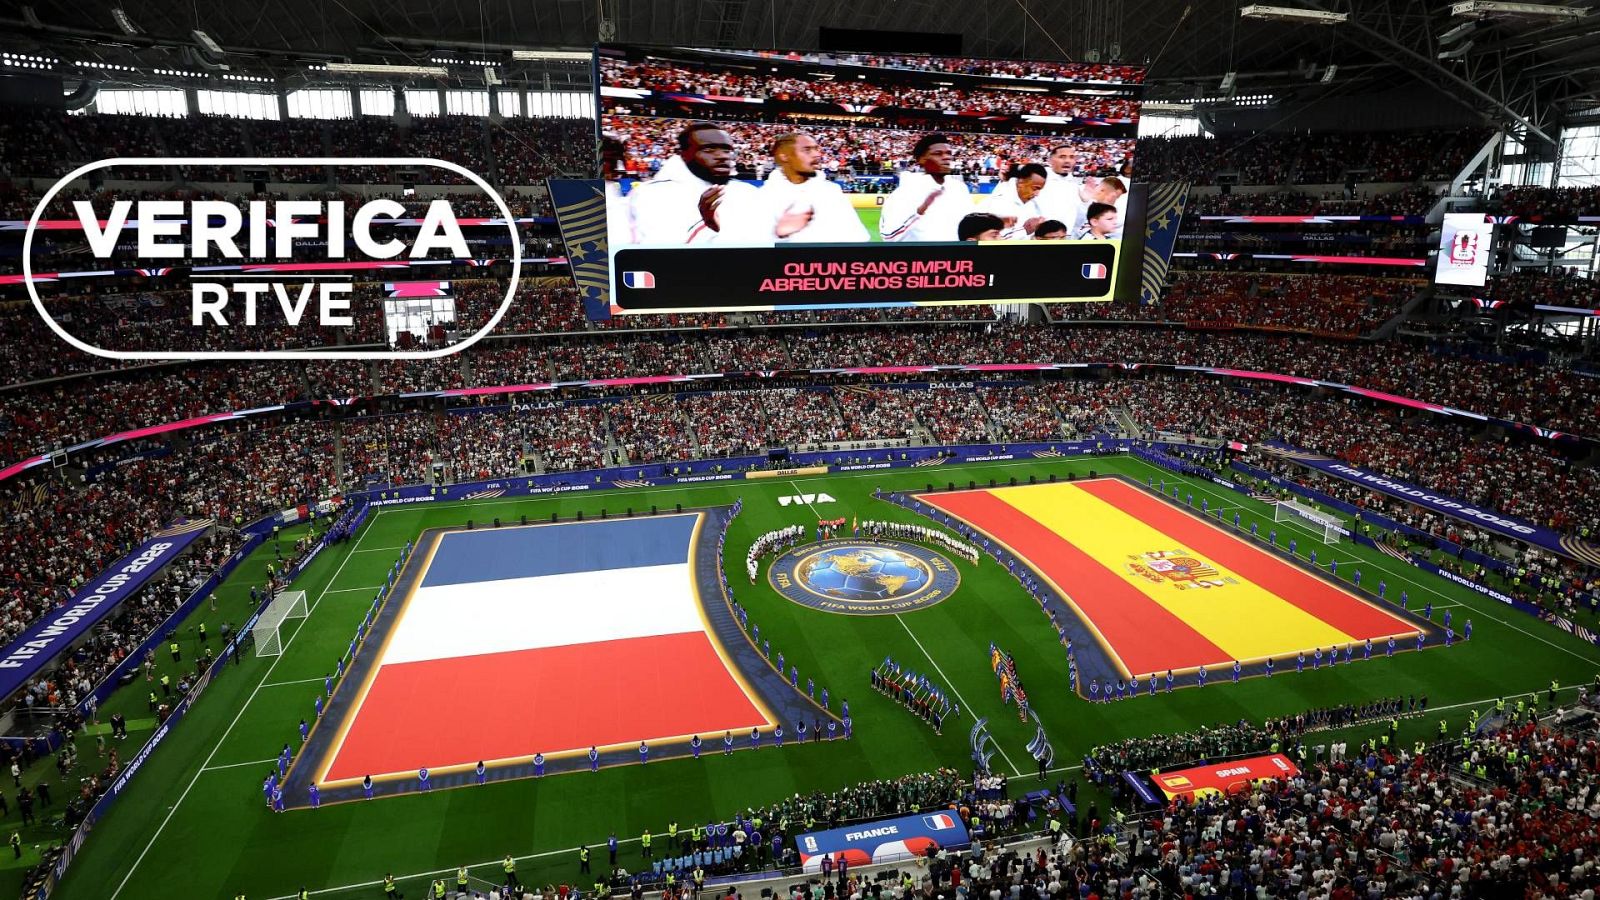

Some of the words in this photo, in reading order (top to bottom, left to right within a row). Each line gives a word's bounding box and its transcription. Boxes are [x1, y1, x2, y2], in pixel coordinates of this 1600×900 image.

[784, 262, 846, 276] QU'UN
[850, 261, 907, 275] SANG
[911, 260, 973, 274] IMPUR
[759, 277, 856, 292] ABREUVE
[860, 276, 902, 290] NOS
[906, 274, 986, 289] SILLONS
[988, 274, 994, 287] !
[1328, 464, 1365, 478] FIFA
[1363, 474, 1425, 497] WORLD
[1422, 495, 1463, 510] CUP
[1458, 507, 1536, 534] 2026
[776, 573, 792, 589] FIFA
[1438, 569, 1452, 579] FIFA
[1452, 574, 1475, 589] WORLD
[1475, 584, 1489, 594] CUP
[1488, 590, 1513, 604] 2026
[0, 637, 55, 668] FIFA
[35, 594, 106, 638] WORLD
[95, 573, 132, 594] CUP
[122, 542, 173, 573] 2026
[820, 601, 845, 609] FIFA
[848, 603, 890, 611] WORLD
[891, 600, 912, 609] CUP
[912, 588, 942, 604] 2026
[84, 694, 98, 710] FIFA
[113, 777, 126, 795] FIFA
[125, 755, 143, 780] WORLD
[142, 743, 153, 758] CUP
[152, 724, 169, 748] 2026
[1216, 766, 1251, 778] SPAIN
[845, 825, 899, 841] FRANCE
